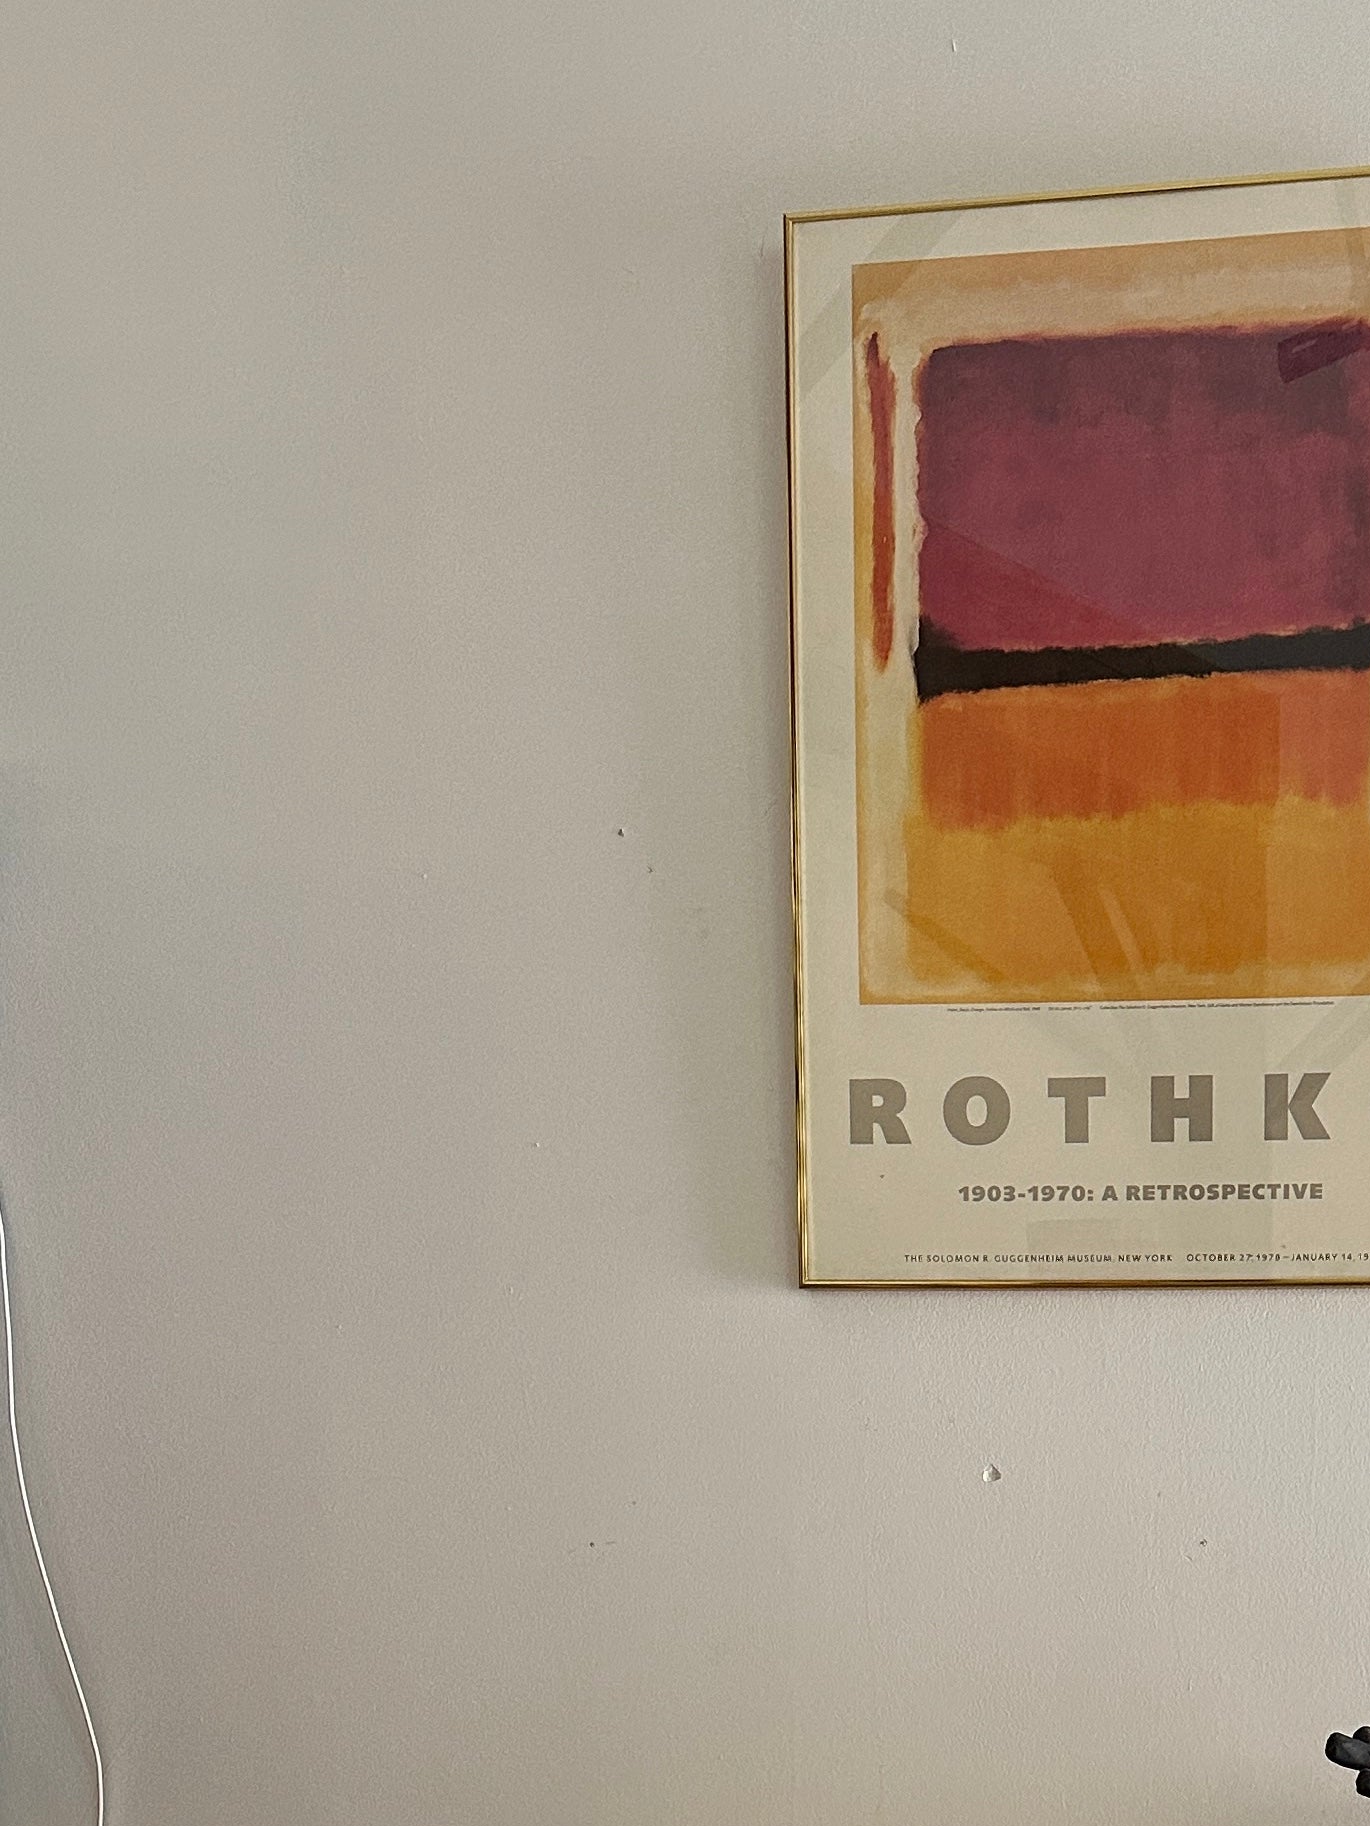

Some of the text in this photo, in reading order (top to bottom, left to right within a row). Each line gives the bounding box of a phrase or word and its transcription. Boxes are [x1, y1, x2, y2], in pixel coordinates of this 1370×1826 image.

[958, 1183, 1324, 1202] 1903-1970: A RETROSPECTIVE
[904, 1253, 923, 1263] THE
[926, 1253, 980, 1263] SOLOMON
[994, 1253, 1064, 1263] GUGGENHEIM
[1118, 1253, 1142, 1263] NEW
[1145, 1253, 1173, 1263] YORK
[1186, 1252, 1236, 1262] OCTOBER
